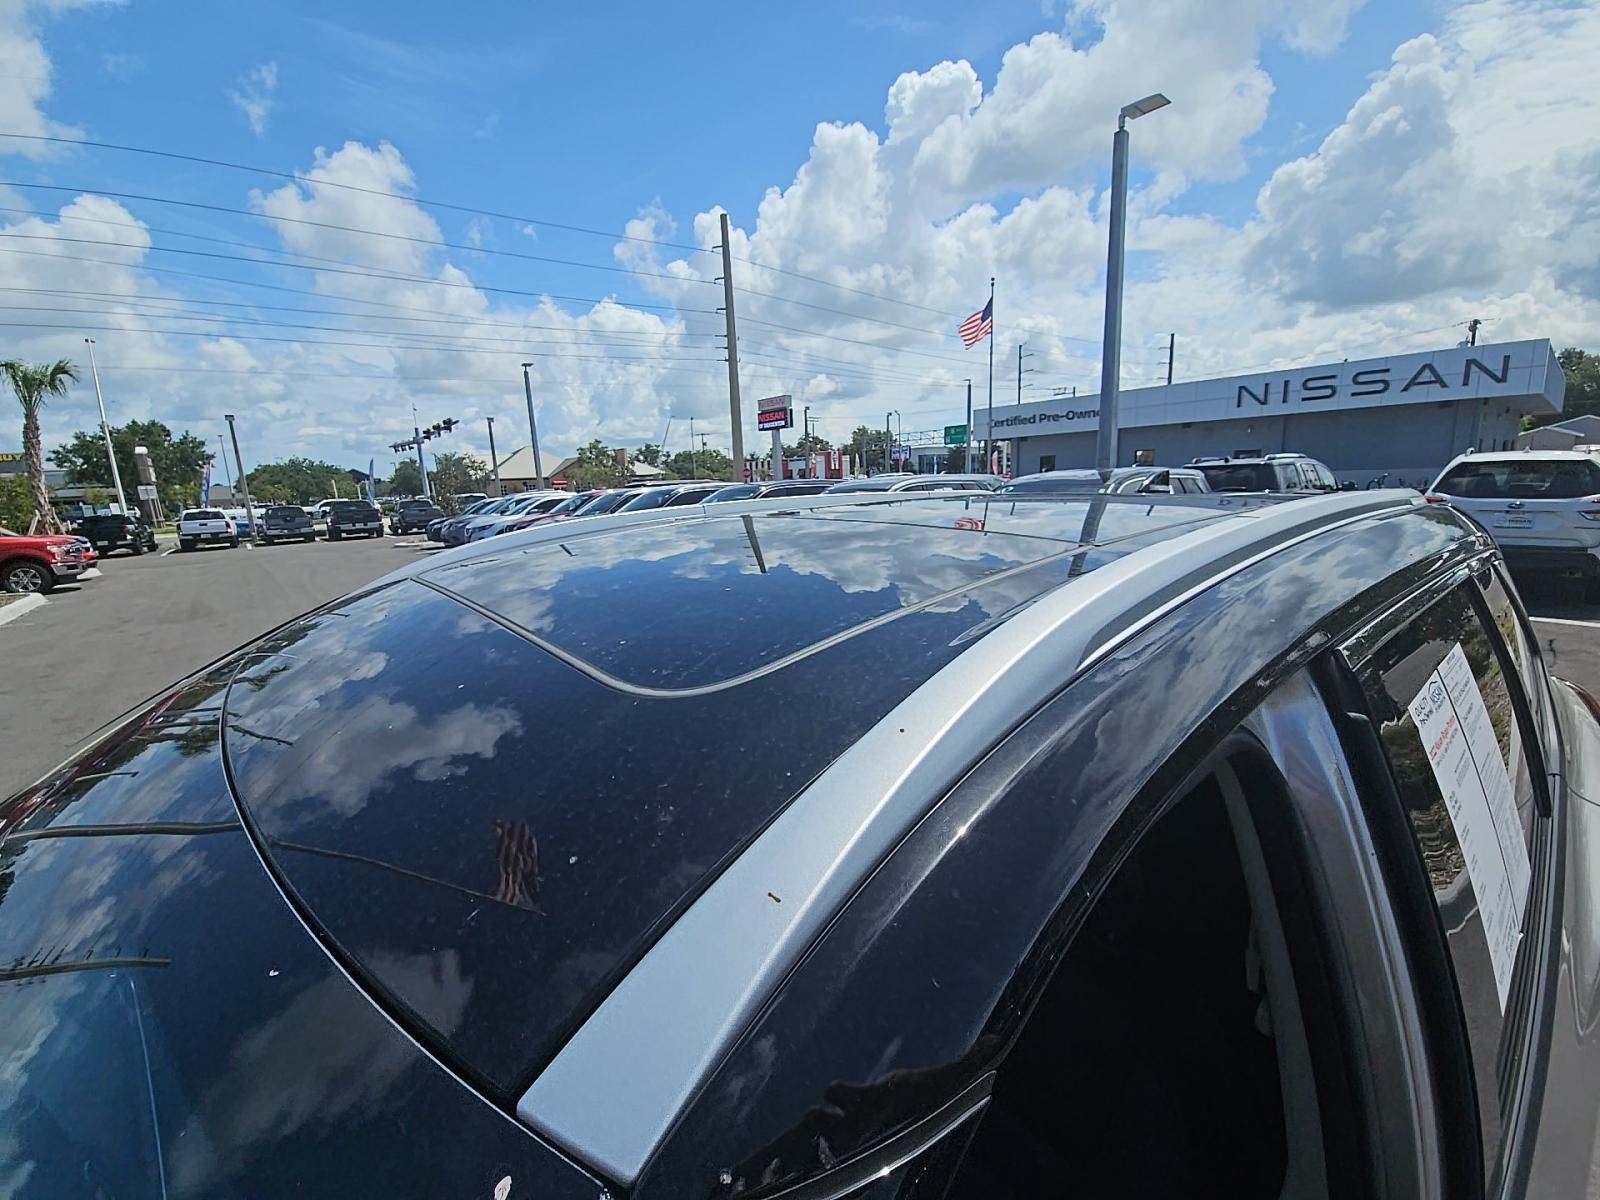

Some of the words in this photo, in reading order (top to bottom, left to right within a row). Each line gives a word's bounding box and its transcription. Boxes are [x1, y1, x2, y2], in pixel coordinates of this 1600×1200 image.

[1236, 355, 1511, 408] NISSAN
[759, 411, 785, 421] NISSAN
[1039, 409, 1100, 423] Pre-Own
